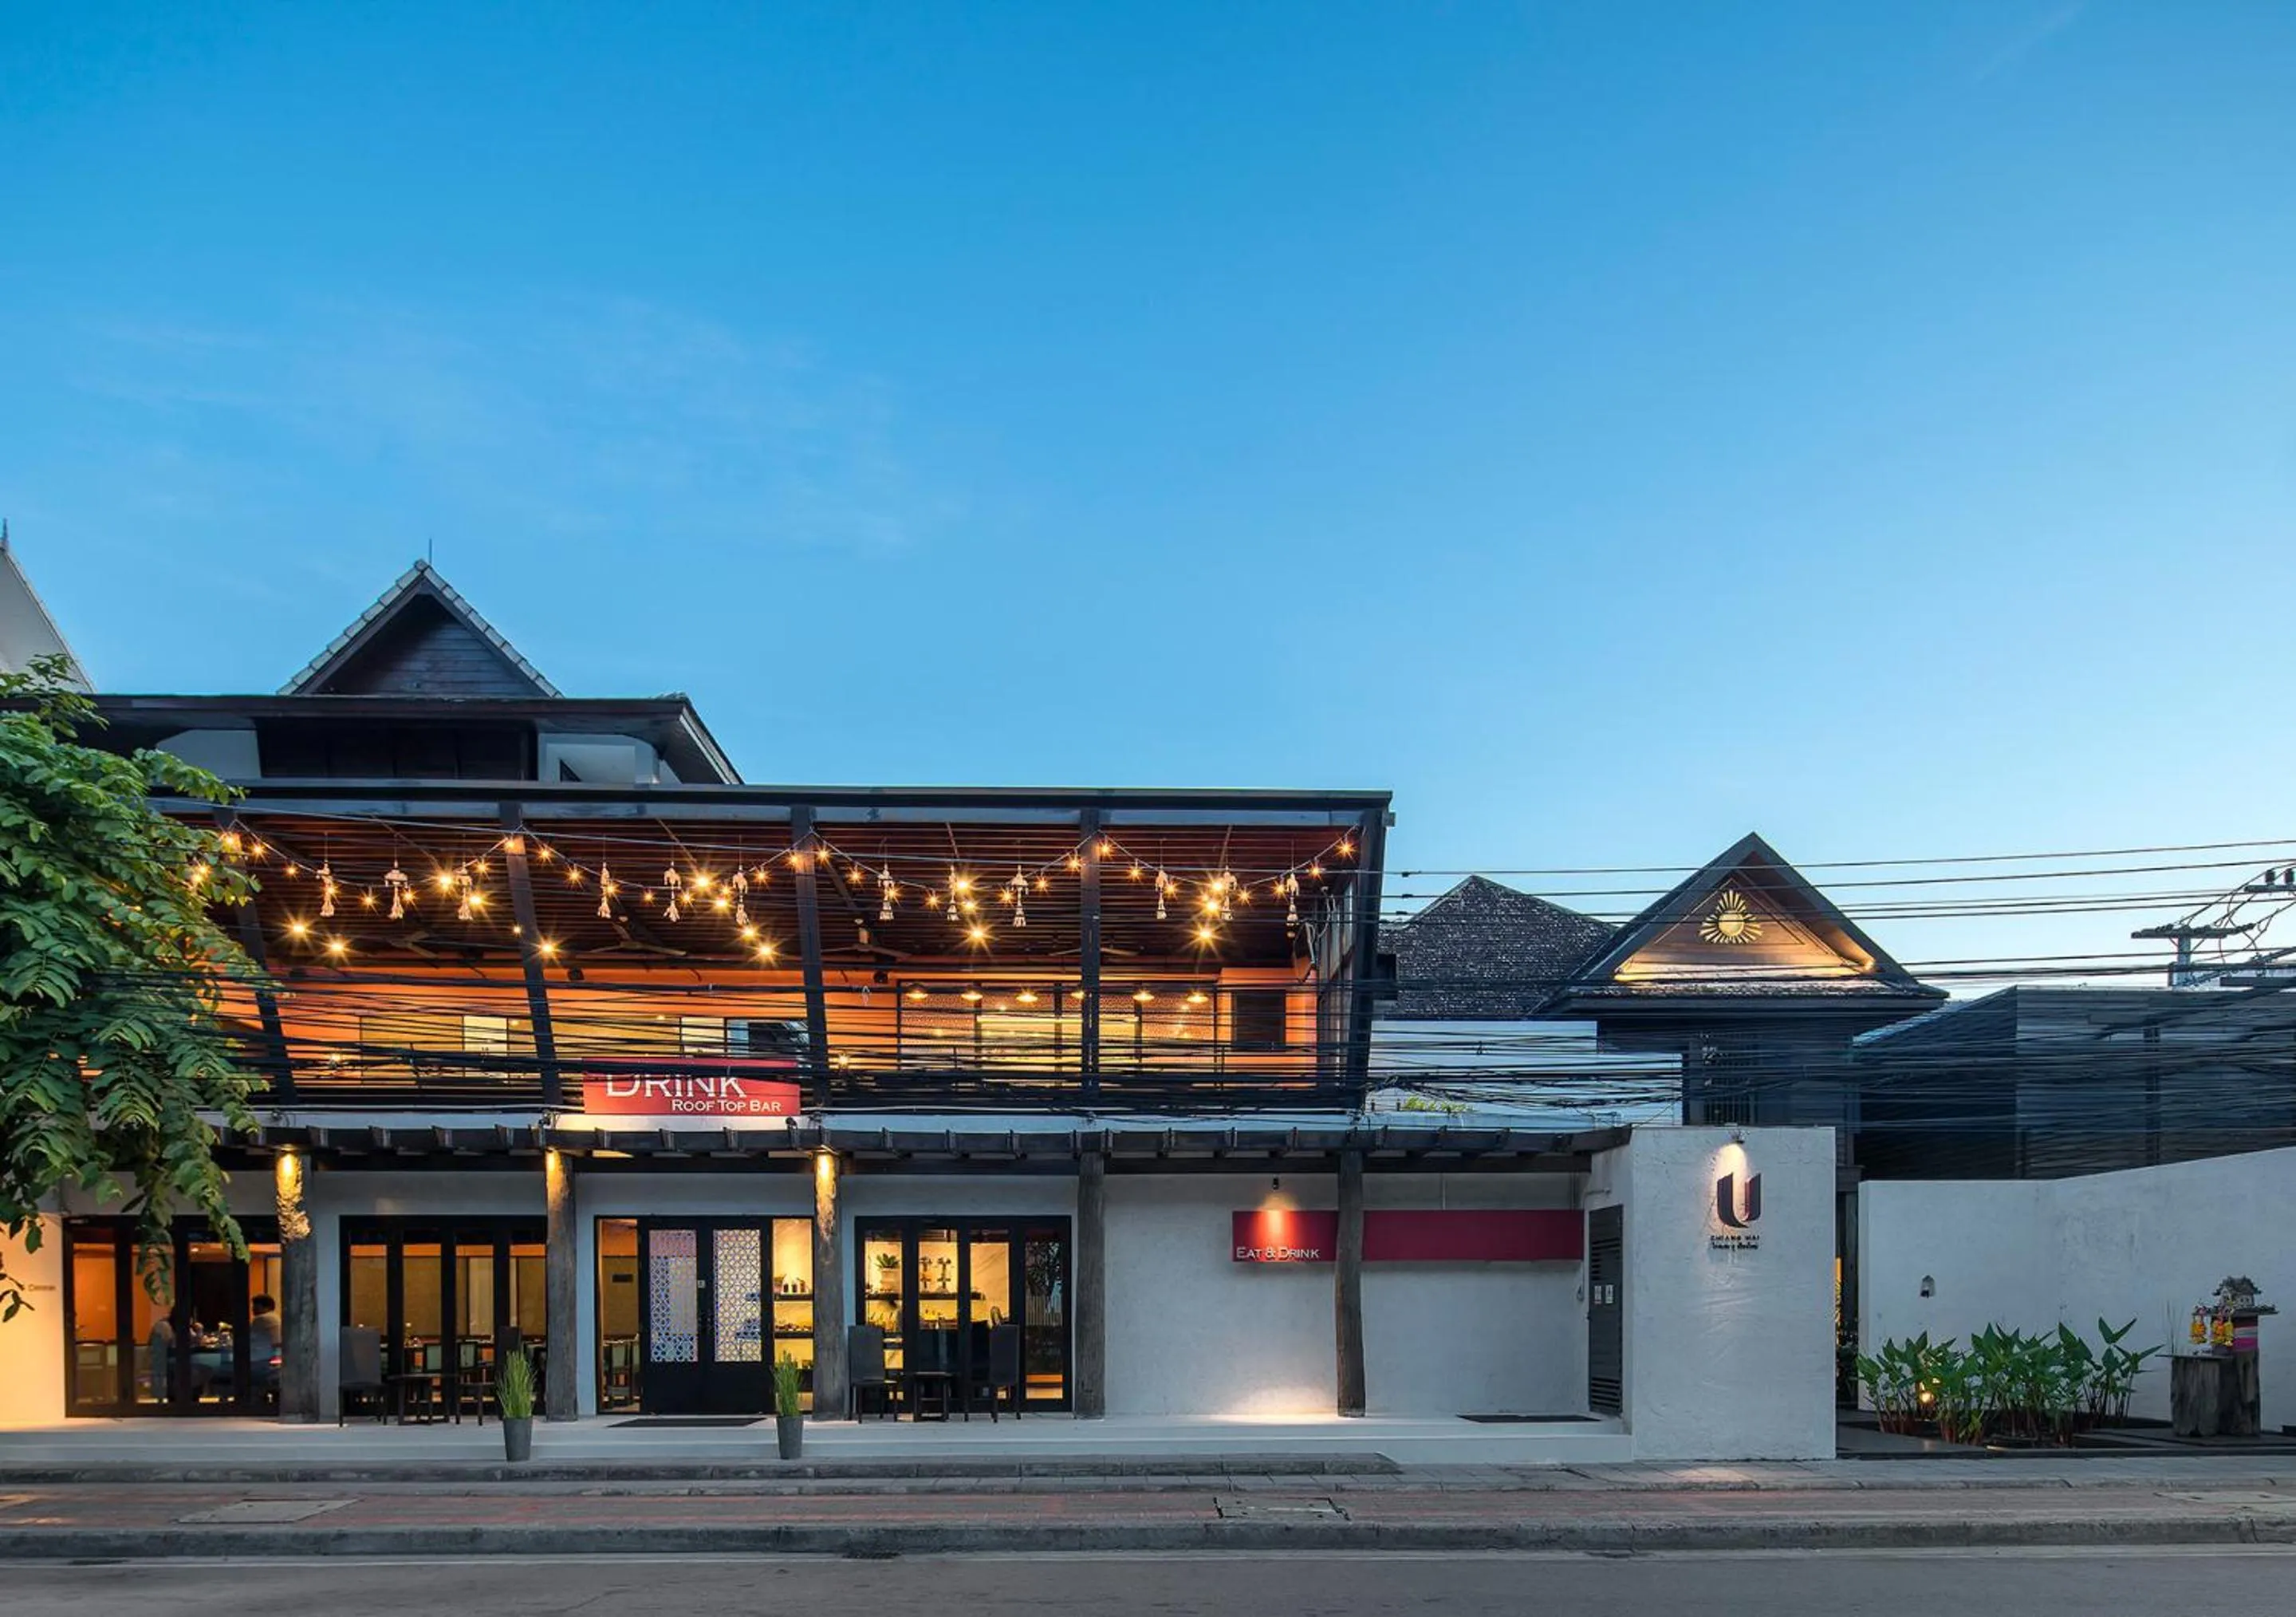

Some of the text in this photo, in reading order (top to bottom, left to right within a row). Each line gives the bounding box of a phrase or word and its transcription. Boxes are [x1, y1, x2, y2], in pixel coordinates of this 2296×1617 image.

[606, 1074, 747, 1098] DRINK
[671, 1098, 782, 1112] ROOF TOP BAR
[1716, 1172, 1762, 1229] U
[1236, 1246, 1321, 1259] EAT & DRINK
